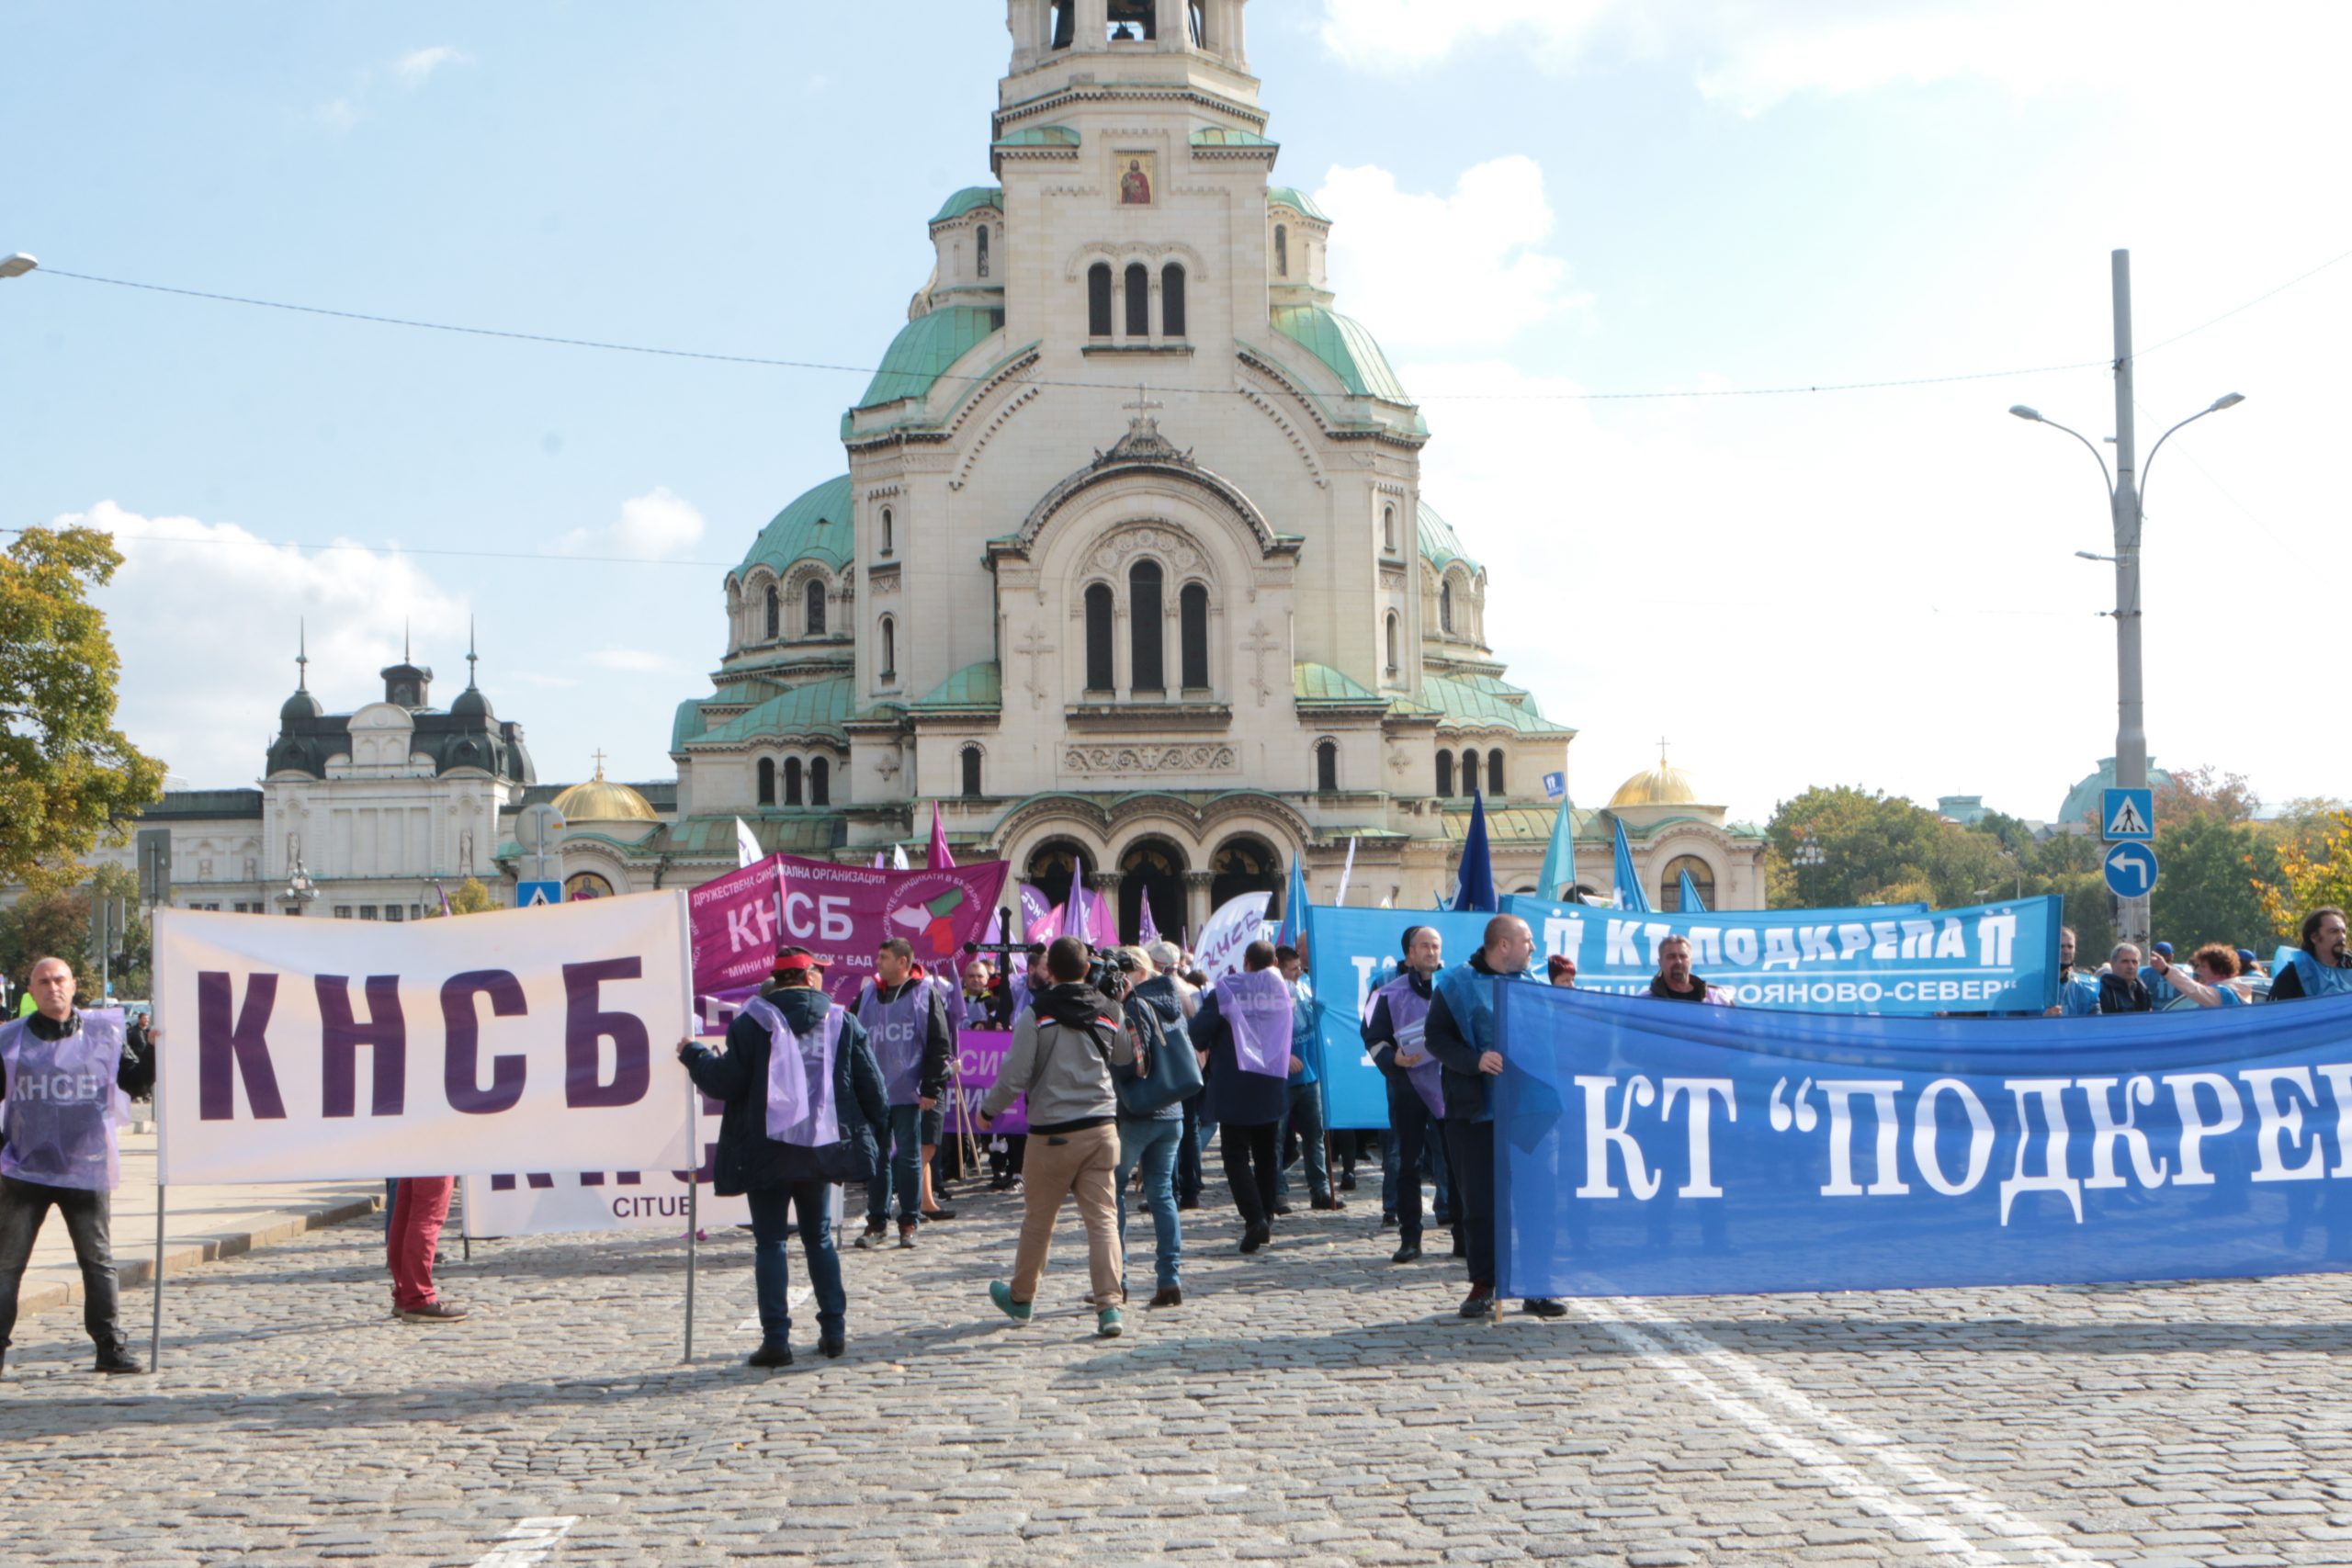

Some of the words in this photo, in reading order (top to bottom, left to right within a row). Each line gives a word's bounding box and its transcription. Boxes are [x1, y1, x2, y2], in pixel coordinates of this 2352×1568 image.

[693, 875, 754, 908] ДРУЖЕСТВЕНА
[812, 867, 887, 886] ОРГАНИЗАЦИЯ
[728, 891, 854, 953] КНСБ
[1200, 910, 1261, 969] КНСБ
[1687, 917, 1966, 971] ПОДКРЕПА
[846, 955, 873, 967] ЕАД
[198, 955, 650, 1121] КНСБ
[11, 1073, 98, 1102] КНСБ
[1575, 1074, 1737, 1201] КТ
